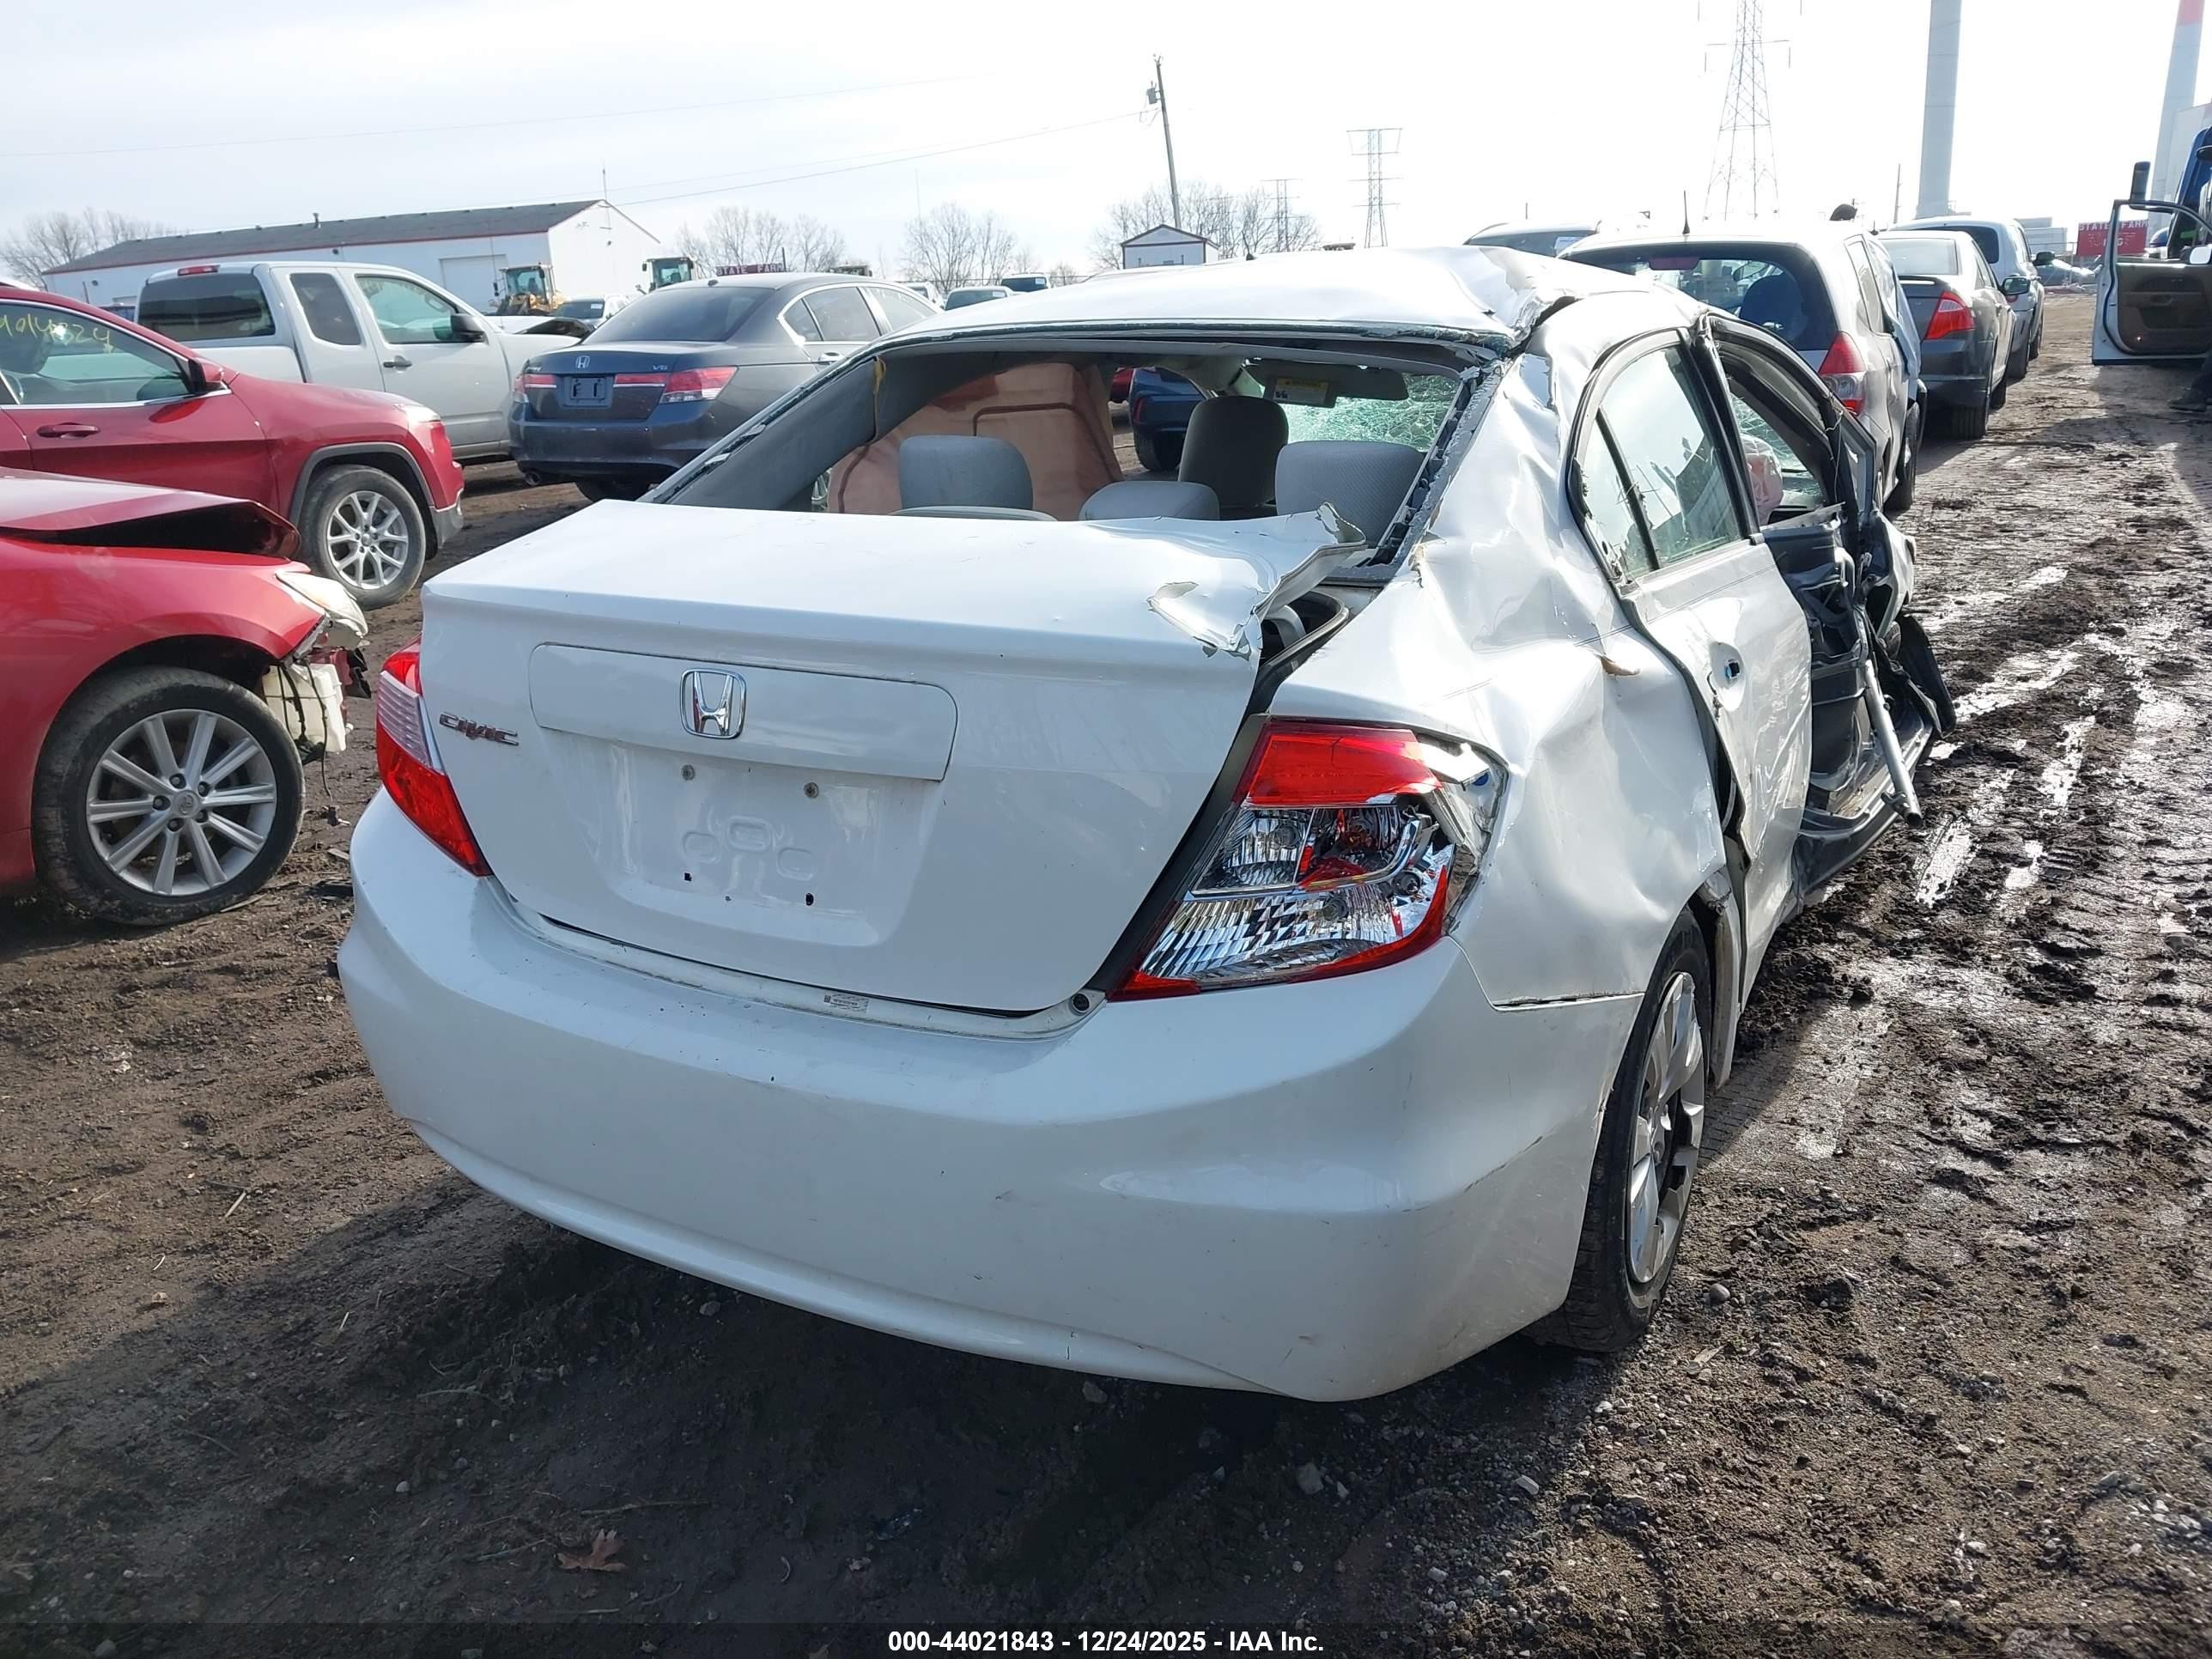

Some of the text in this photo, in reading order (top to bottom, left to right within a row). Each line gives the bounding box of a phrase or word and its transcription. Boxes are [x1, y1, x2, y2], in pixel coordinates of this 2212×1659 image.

[2079, 222, 2109, 231] STATE
[716, 263, 784, 276] STATE FARM
[439, 713, 520, 746] CIVIC
